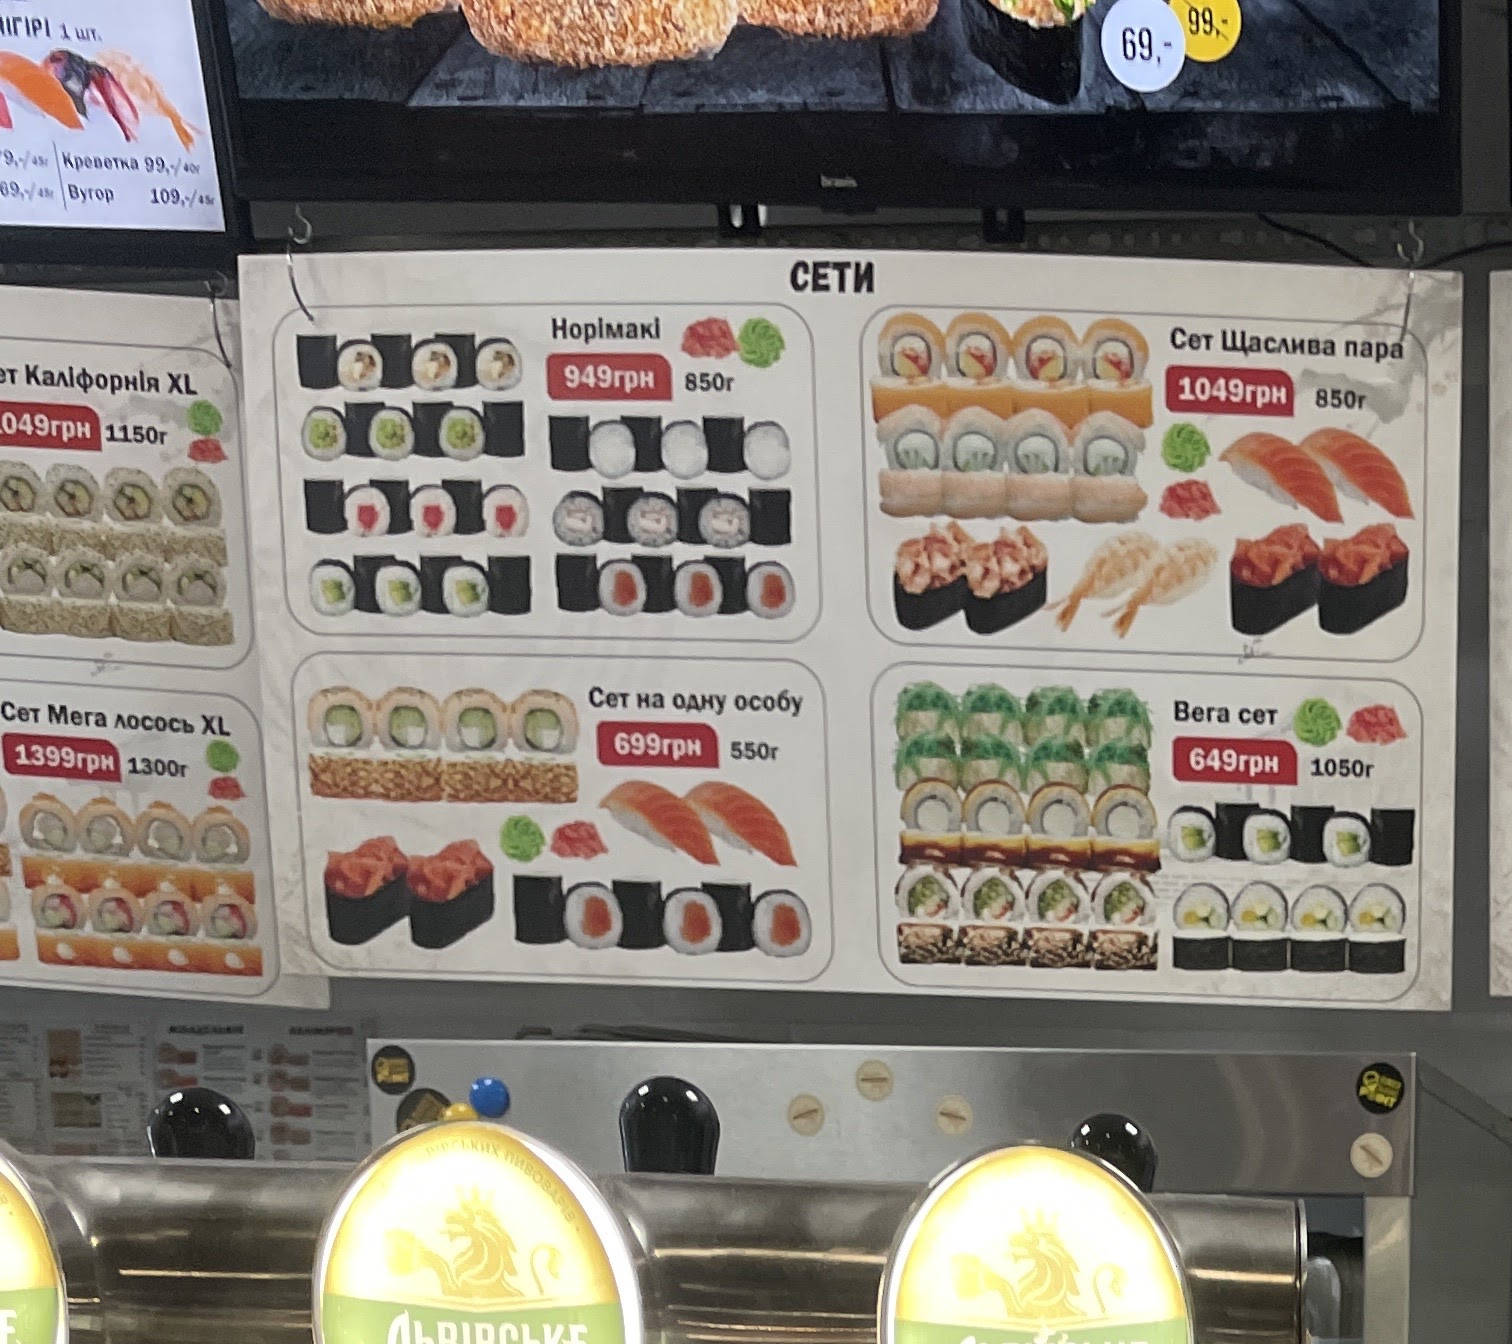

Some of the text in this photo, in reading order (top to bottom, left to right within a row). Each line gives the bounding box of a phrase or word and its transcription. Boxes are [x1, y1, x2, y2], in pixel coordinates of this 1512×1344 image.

[60, 23, 71, 41] 1
[67, 184, 114, 202] Вугор
[790, 260, 875, 294] СЕТИ
[551, 317, 661, 345] Норімакі
[1170, 327, 1405, 363] Сет Щаслива пара
[24, 363, 198, 396] Каліфорнія XL
[563, 364, 735, 394] 949грн 850г
[1177, 376, 1366, 411] 1049грн 850г
[105, 424, 168, 446] 1150г
[588, 686, 803, 717] Сет на одну особу
[1174, 700, 1278, 725] Вега сет
[1, 701, 231, 737] Сет Мега лосось XL
[14, 744, 188, 779] 1399грн 1300г
[613, 732, 779, 761] 699грн 550г
[1189, 747, 1375, 779] 649грн 1050г
